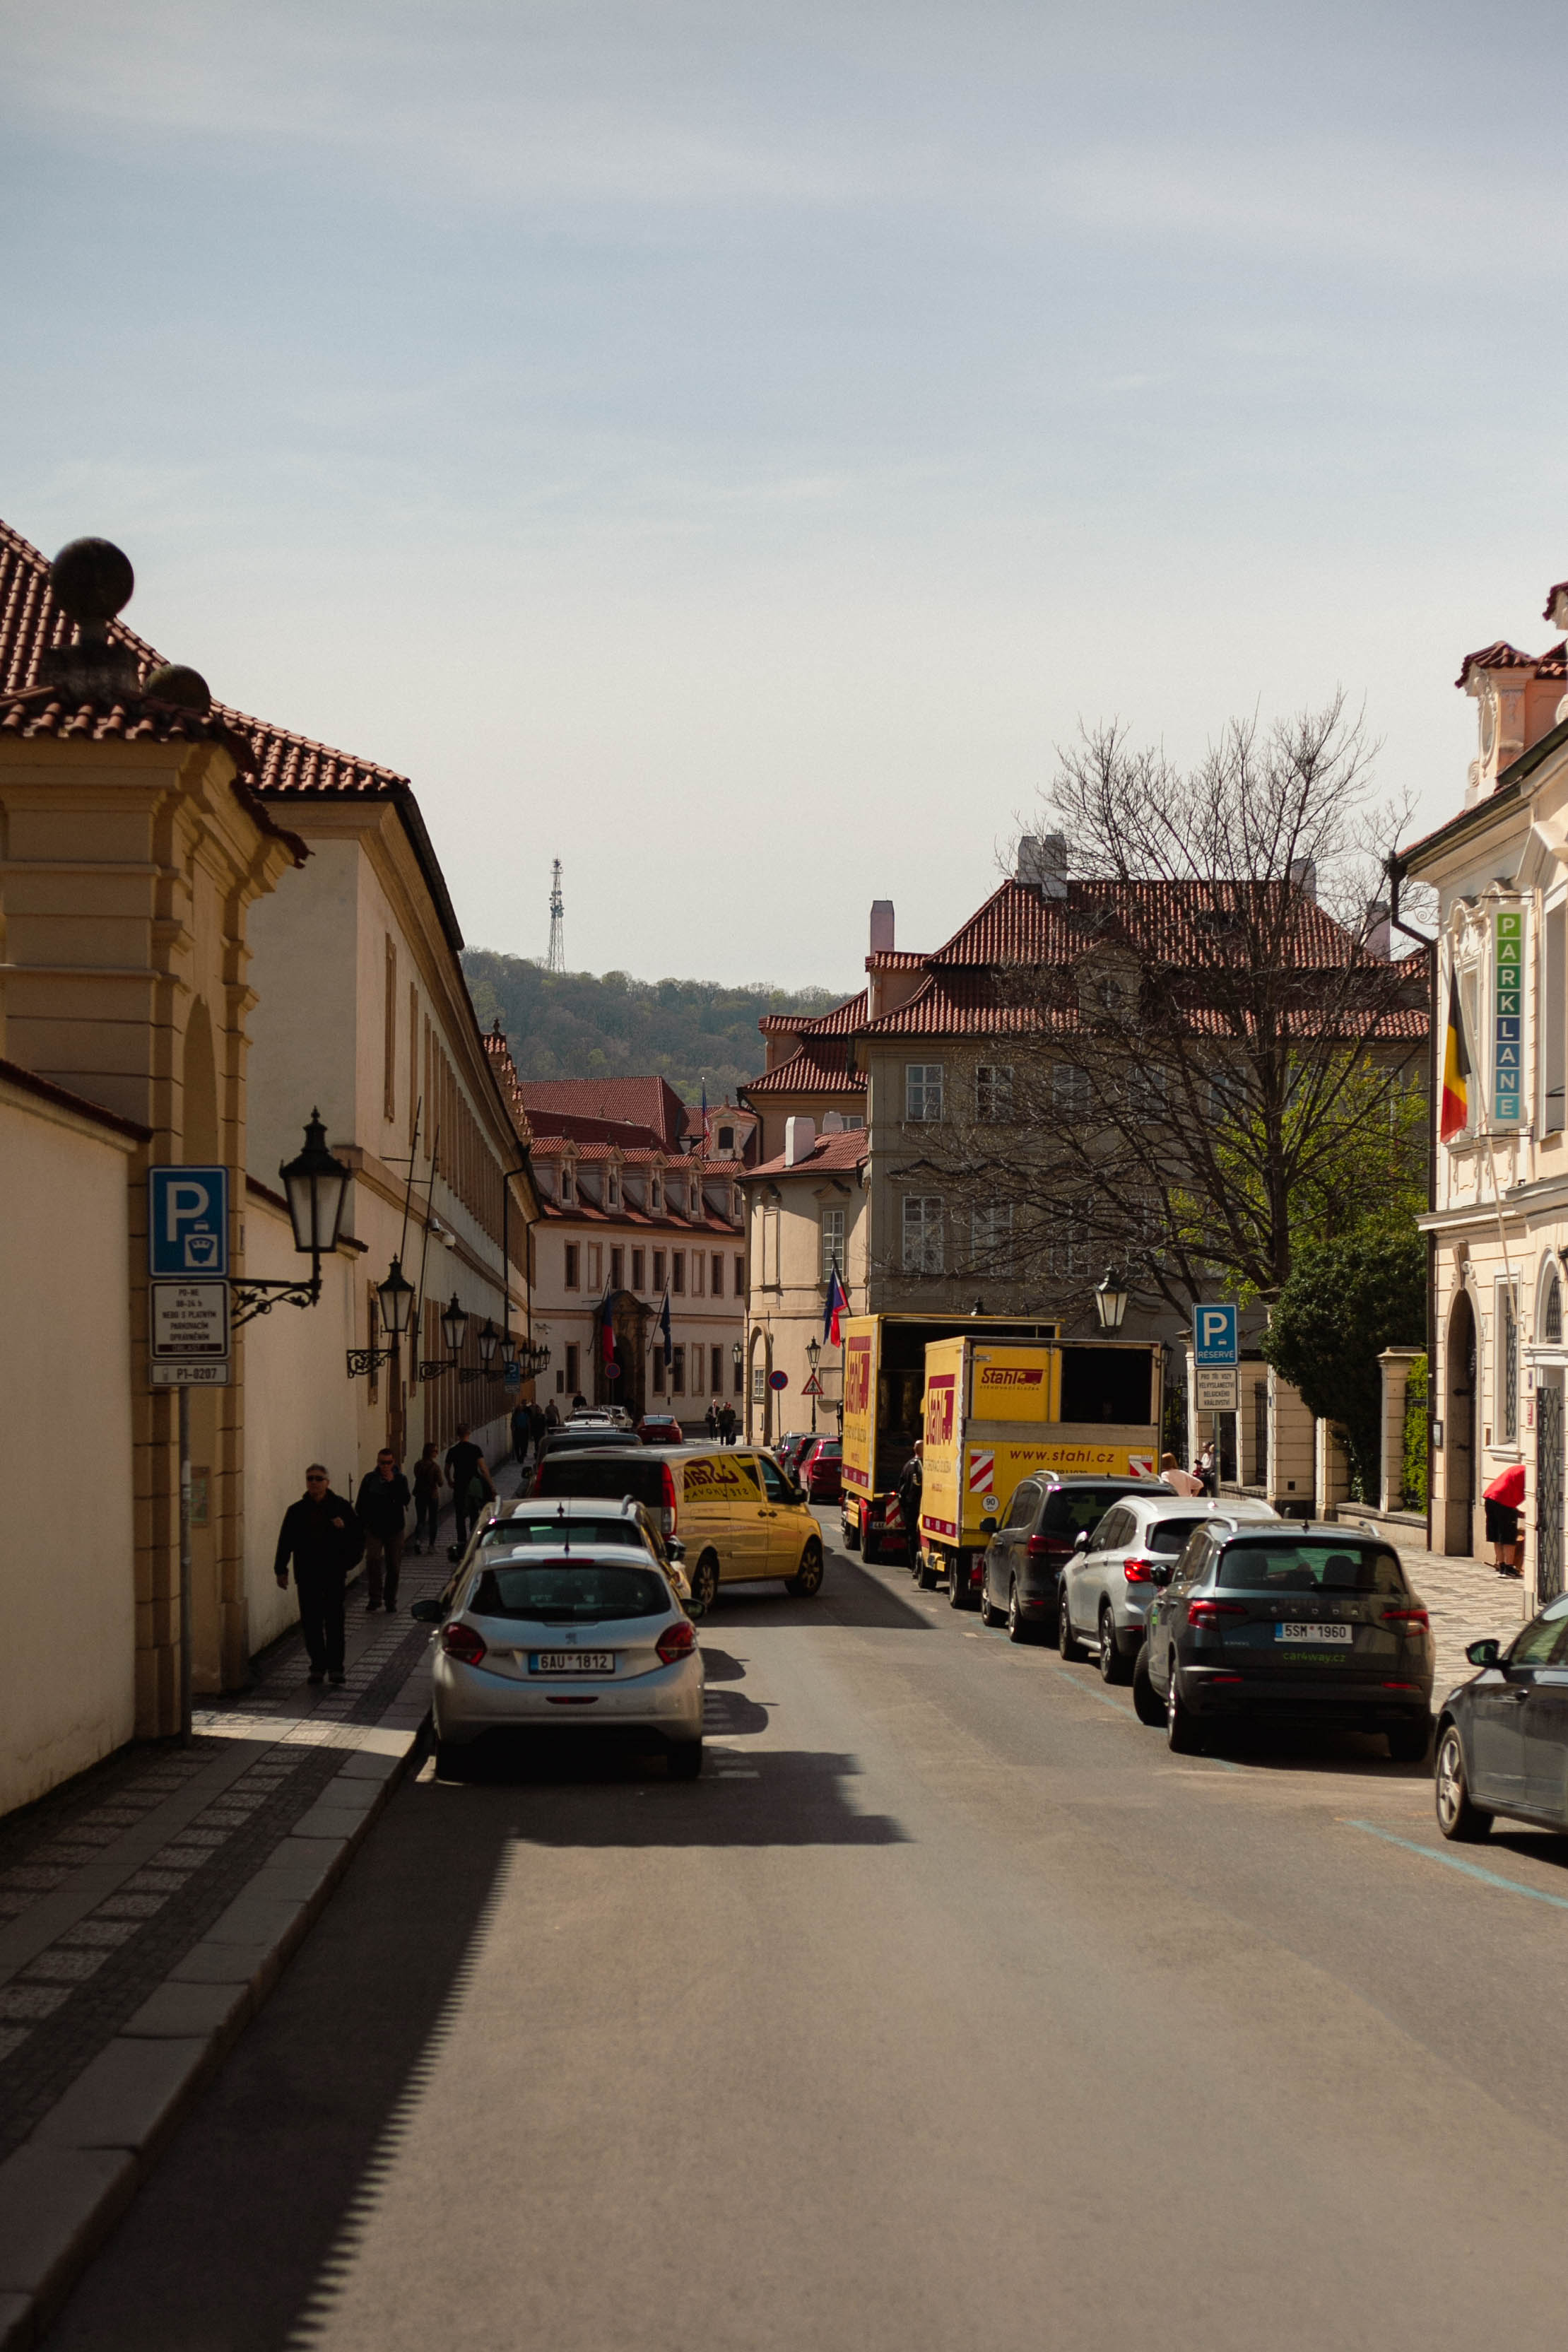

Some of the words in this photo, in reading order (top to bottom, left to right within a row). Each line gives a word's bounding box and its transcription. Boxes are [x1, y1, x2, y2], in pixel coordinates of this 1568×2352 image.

[166, 1181, 210, 1242] P
[1203, 1312, 1228, 1347] P
[177, 1368, 217, 1380] P1-0207
[981, 1368, 1019, 1385] Stahl
[1010, 1450, 1115, 1463] www.stahl.cz
[1285, 1625, 1308, 1637] 5SM
[1317, 1626, 1347, 1638] 1960
[541, 1656, 565, 1669] 6AU
[576, 1656, 608, 1669] 1812
[1283, 1652, 1346, 1664] car4way.cz
